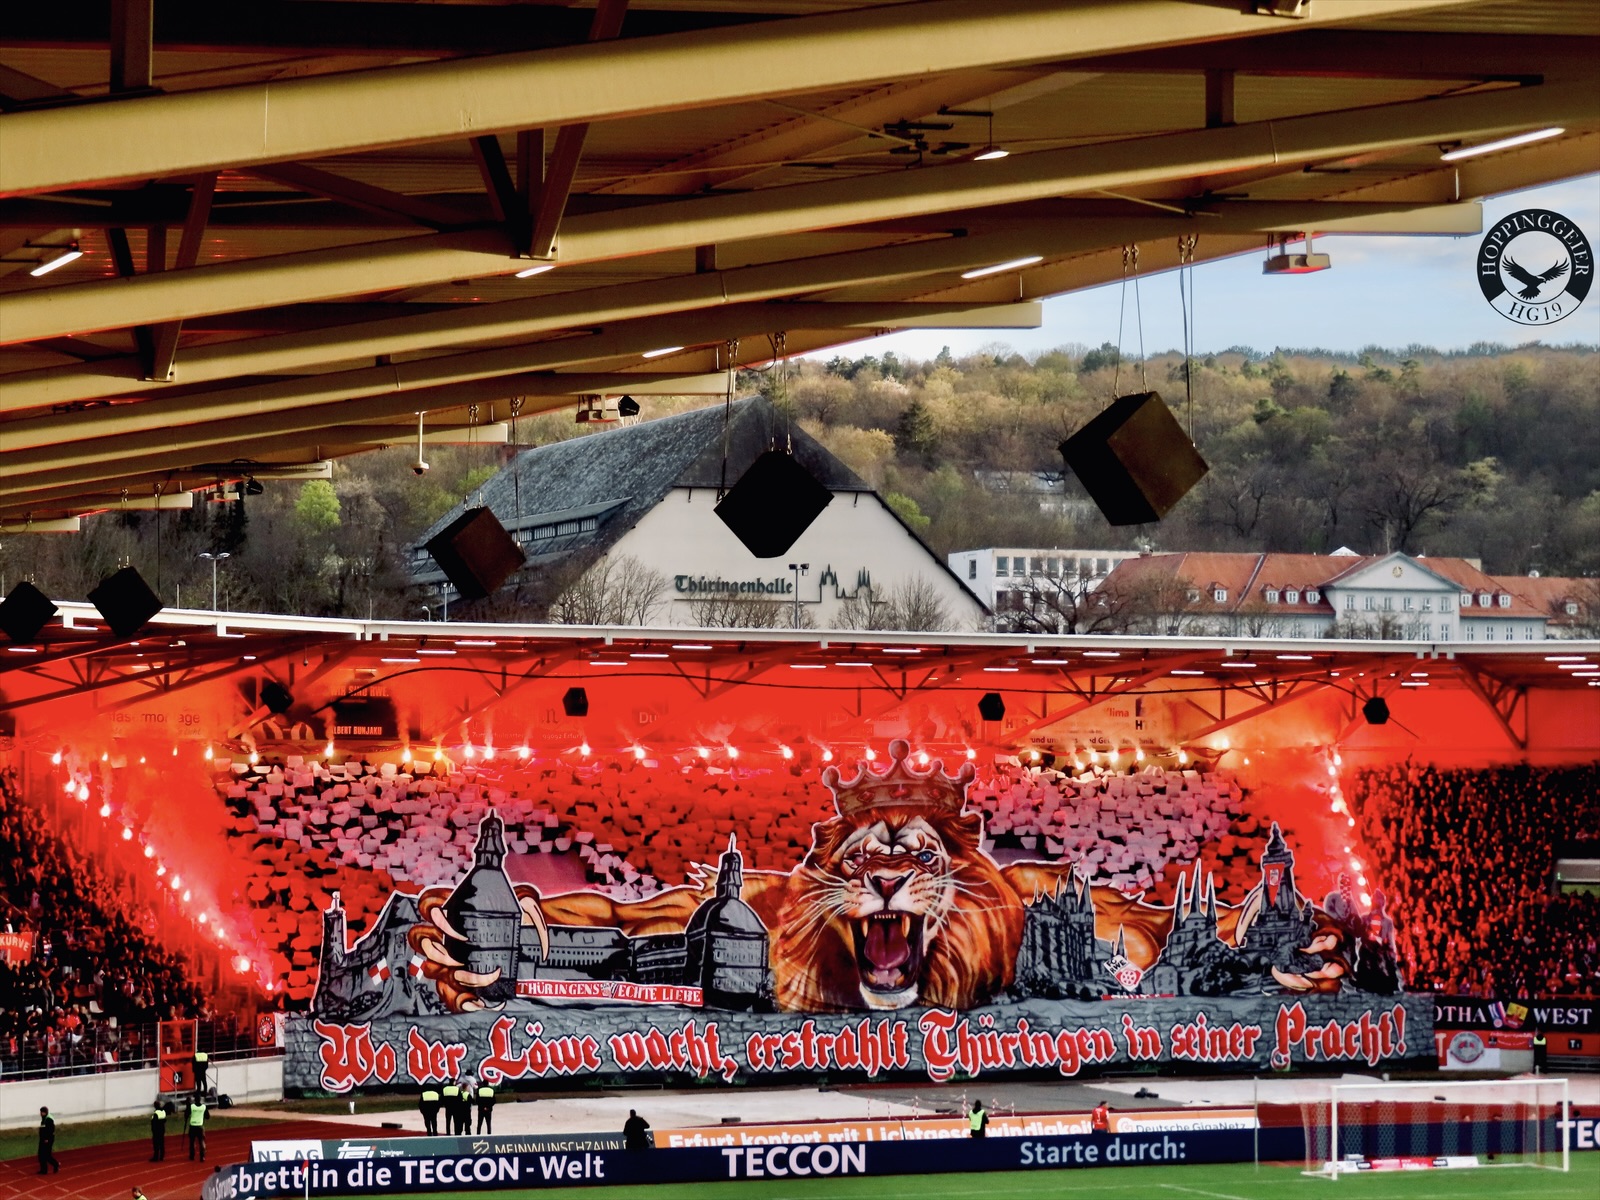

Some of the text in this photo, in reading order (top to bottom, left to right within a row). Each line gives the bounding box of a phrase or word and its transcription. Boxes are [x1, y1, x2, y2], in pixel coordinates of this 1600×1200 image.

[674, 575, 793, 594] Thüringenhalle
[1104, 707, 1129, 718] lima
[331, 726, 351, 734] LBERT
[1028, 736, 1045, 744] und
[518, 981, 701, 1003] THÜRINGENS ECHTE LIEBE
[1533, 1007, 1593, 1025] WEST
[313, 1018, 397, 1092] Wo
[407, 1024, 467, 1083] der
[477, 1014, 601, 1085] Löwe
[608, 1020, 738, 1083] wacht,
[746, 1016, 911, 1078] erstrahlt
[918, 1008, 1117, 1082] Thüringen
[1121, 1012, 1163, 1061] in
[1171, 1011, 1263, 1061] seiner
[1271, 1001, 1411, 1071] Pracht!
[669, 1120, 1092, 1147] Erfurt kontert mit Lichtgescwindigkeit
[1136, 1123, 1190, 1132] Deutsche
[1021, 1135, 1186, 1165] Starte durch:
[313, 1163, 338, 1188] in
[347, 1161, 392, 1187] die
[399, 1156, 519, 1185] TECCON
[540, 1153, 605, 1180] Welt
[722, 1143, 866, 1178] TECCON
